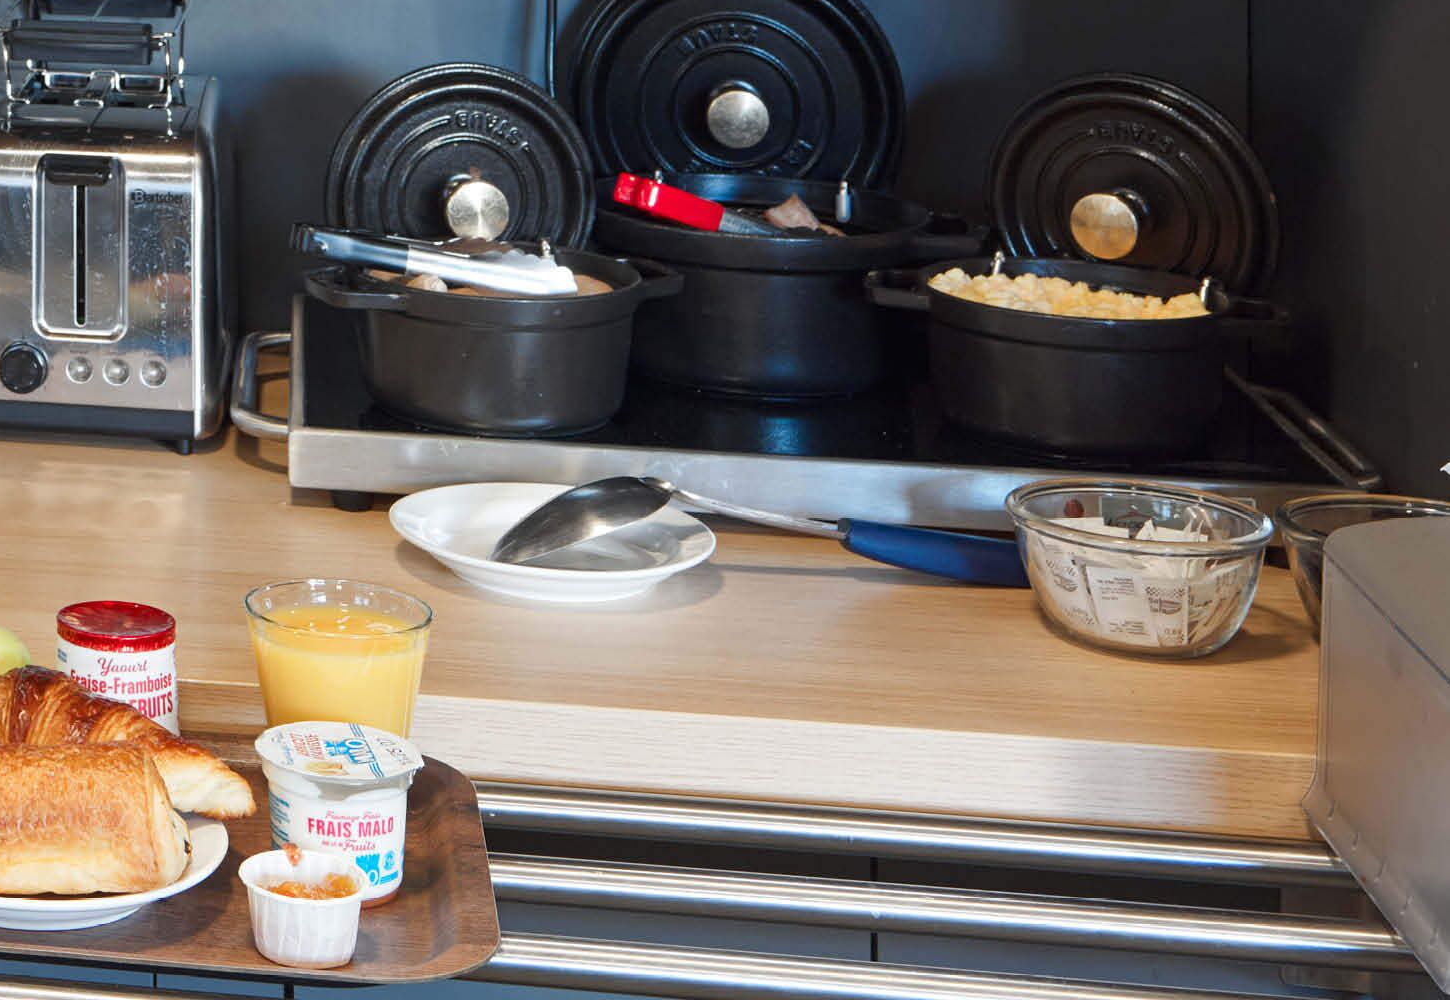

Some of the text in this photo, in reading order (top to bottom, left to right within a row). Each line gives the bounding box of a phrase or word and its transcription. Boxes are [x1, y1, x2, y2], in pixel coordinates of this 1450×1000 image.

[97, 656, 149, 677] Yaourt
[307, 815, 395, 838] FRAIS MALO
[342, 839, 377, 852] Fruits
